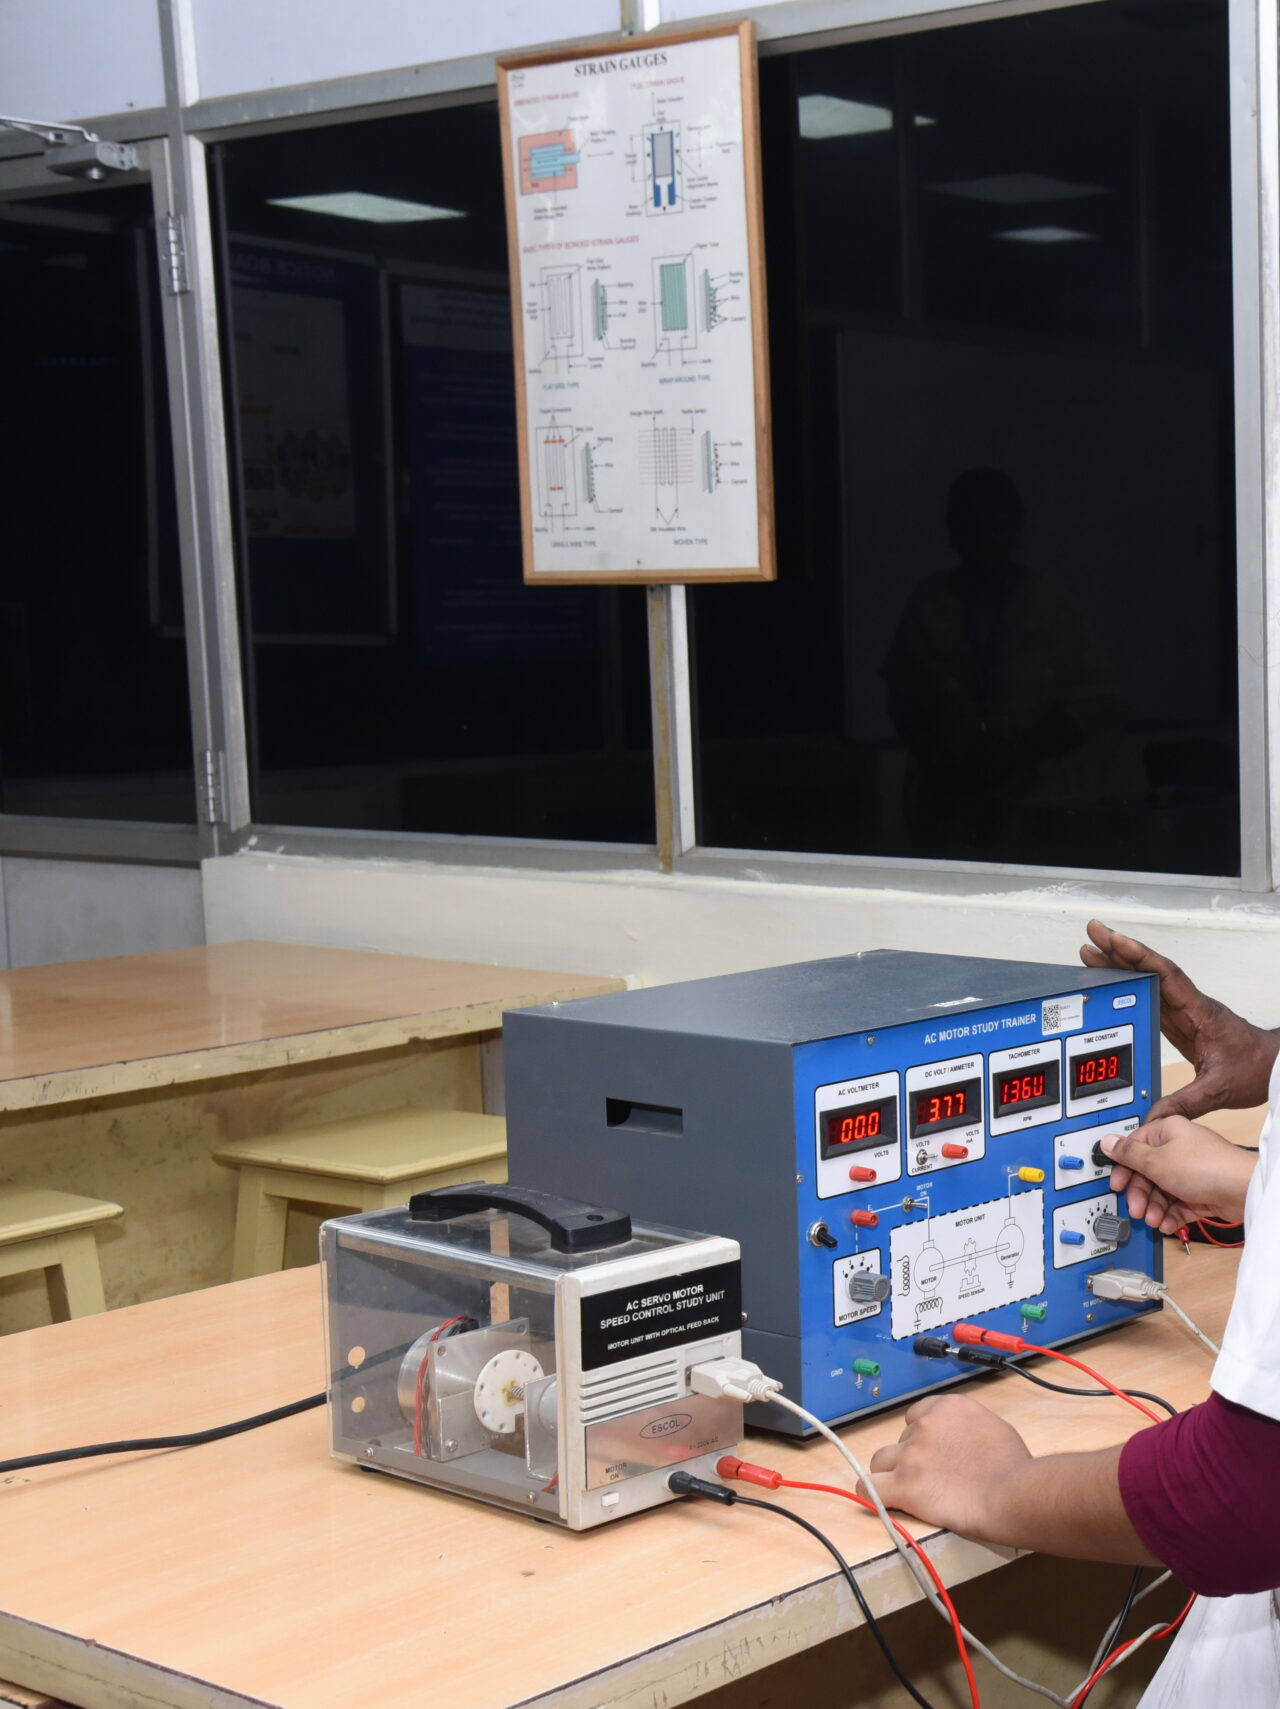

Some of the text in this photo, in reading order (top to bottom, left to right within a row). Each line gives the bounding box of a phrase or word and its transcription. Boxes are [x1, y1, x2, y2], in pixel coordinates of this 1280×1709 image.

[574, 54, 668, 77] STRAIN GAUGES
[924, 1013, 1037, 1045] AC MOTOR STUDY TRAINER
[1083, 1031, 1119, 1045] TIME CONSTANT
[1008, 1047, 1041, 1060] TACHOMETER
[933, 1068, 947, 1076] VOLT
[950, 1061, 975, 1073] AMMETER
[1080, 1055, 1118, 1083] 1038
[838, 1082, 879, 1096] AC VOLTMETER
[965, 1129, 979, 1137] VOLTS
[1124, 1123, 1138, 1131] RESET
[874, 1150, 889, 1158] VOLTS
[911, 1163, 933, 1173] CURRENT
[1094, 1169, 1103, 1177] REF
[916, 1182, 933, 1191] MOTOR
[955, 1214, 985, 1228] MOTOR UNIT
[1001, 1251, 1020, 1261] Generator
[1090, 1245, 1111, 1256] LOADING
[921, 1276, 937, 1286] MOTOR
[626, 1284, 704, 1312] AC SERVO MOTOR
[958, 1287, 985, 1300] SPEED SENSOR
[600, 1290, 725, 1330] SPEED CONTROL STUDY UNIT
[839, 1305, 877, 1322] MOTOR SPEED
[607, 1316, 720, 1350] MOTOR UNIT WITH OPTICAL FEED BACK
[830, 1367, 843, 1377] GND
[651, 1418, 681, 1434] ESCOL
[605, 1462, 627, 1474] MOTOR
